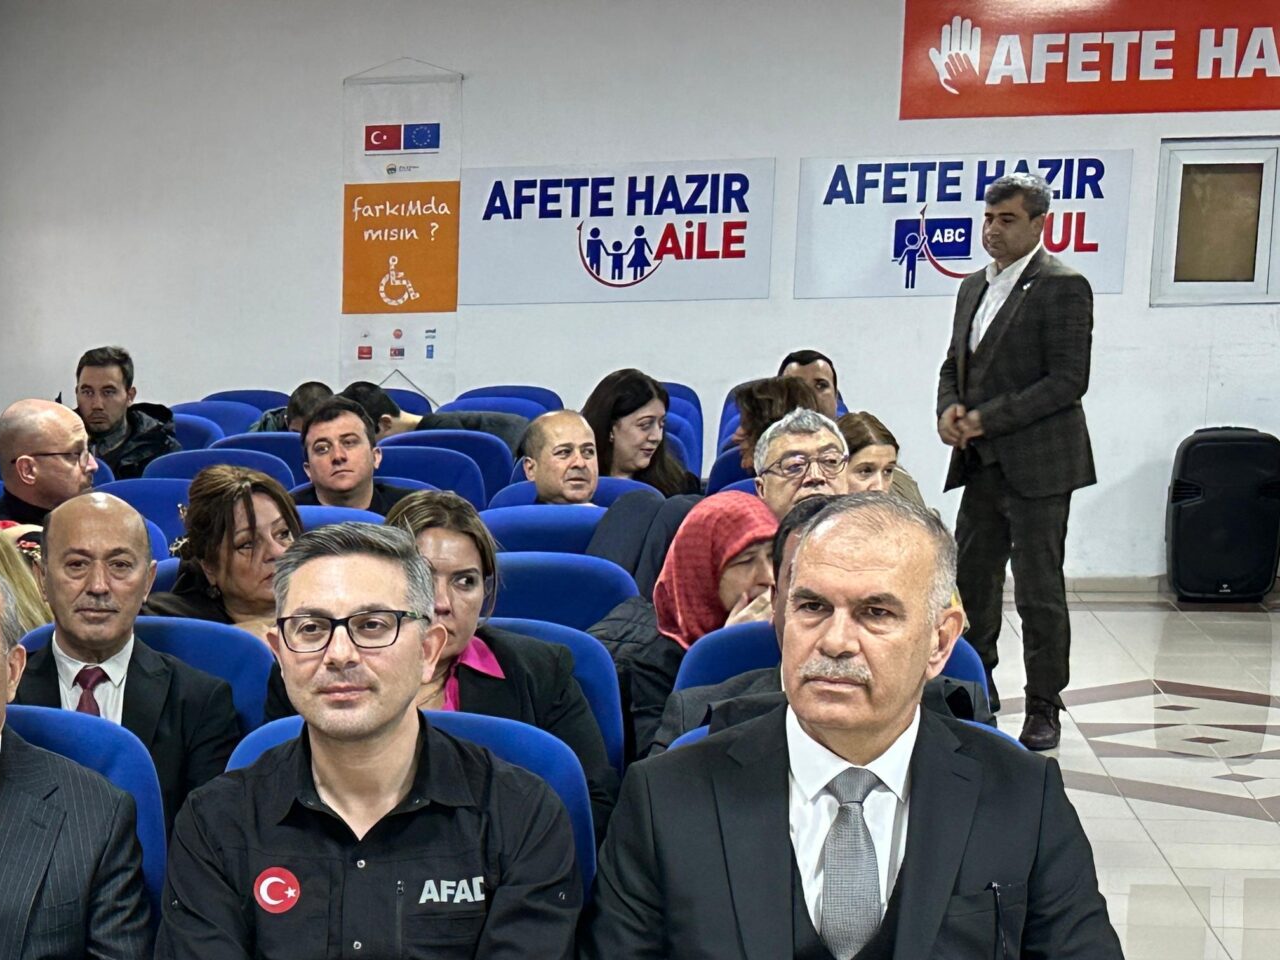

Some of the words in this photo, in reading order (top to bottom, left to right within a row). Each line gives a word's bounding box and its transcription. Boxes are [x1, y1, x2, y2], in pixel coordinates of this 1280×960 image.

[985, 29, 1176, 85] AFETE
[482, 176, 615, 221] AFETE
[626, 173, 750, 216] HAZIR
[823, 161, 964, 205] AFETE
[975, 157, 1105, 201] HZIR
[931, 227, 966, 244] ABC
[1042, 211, 1099, 254] UL
